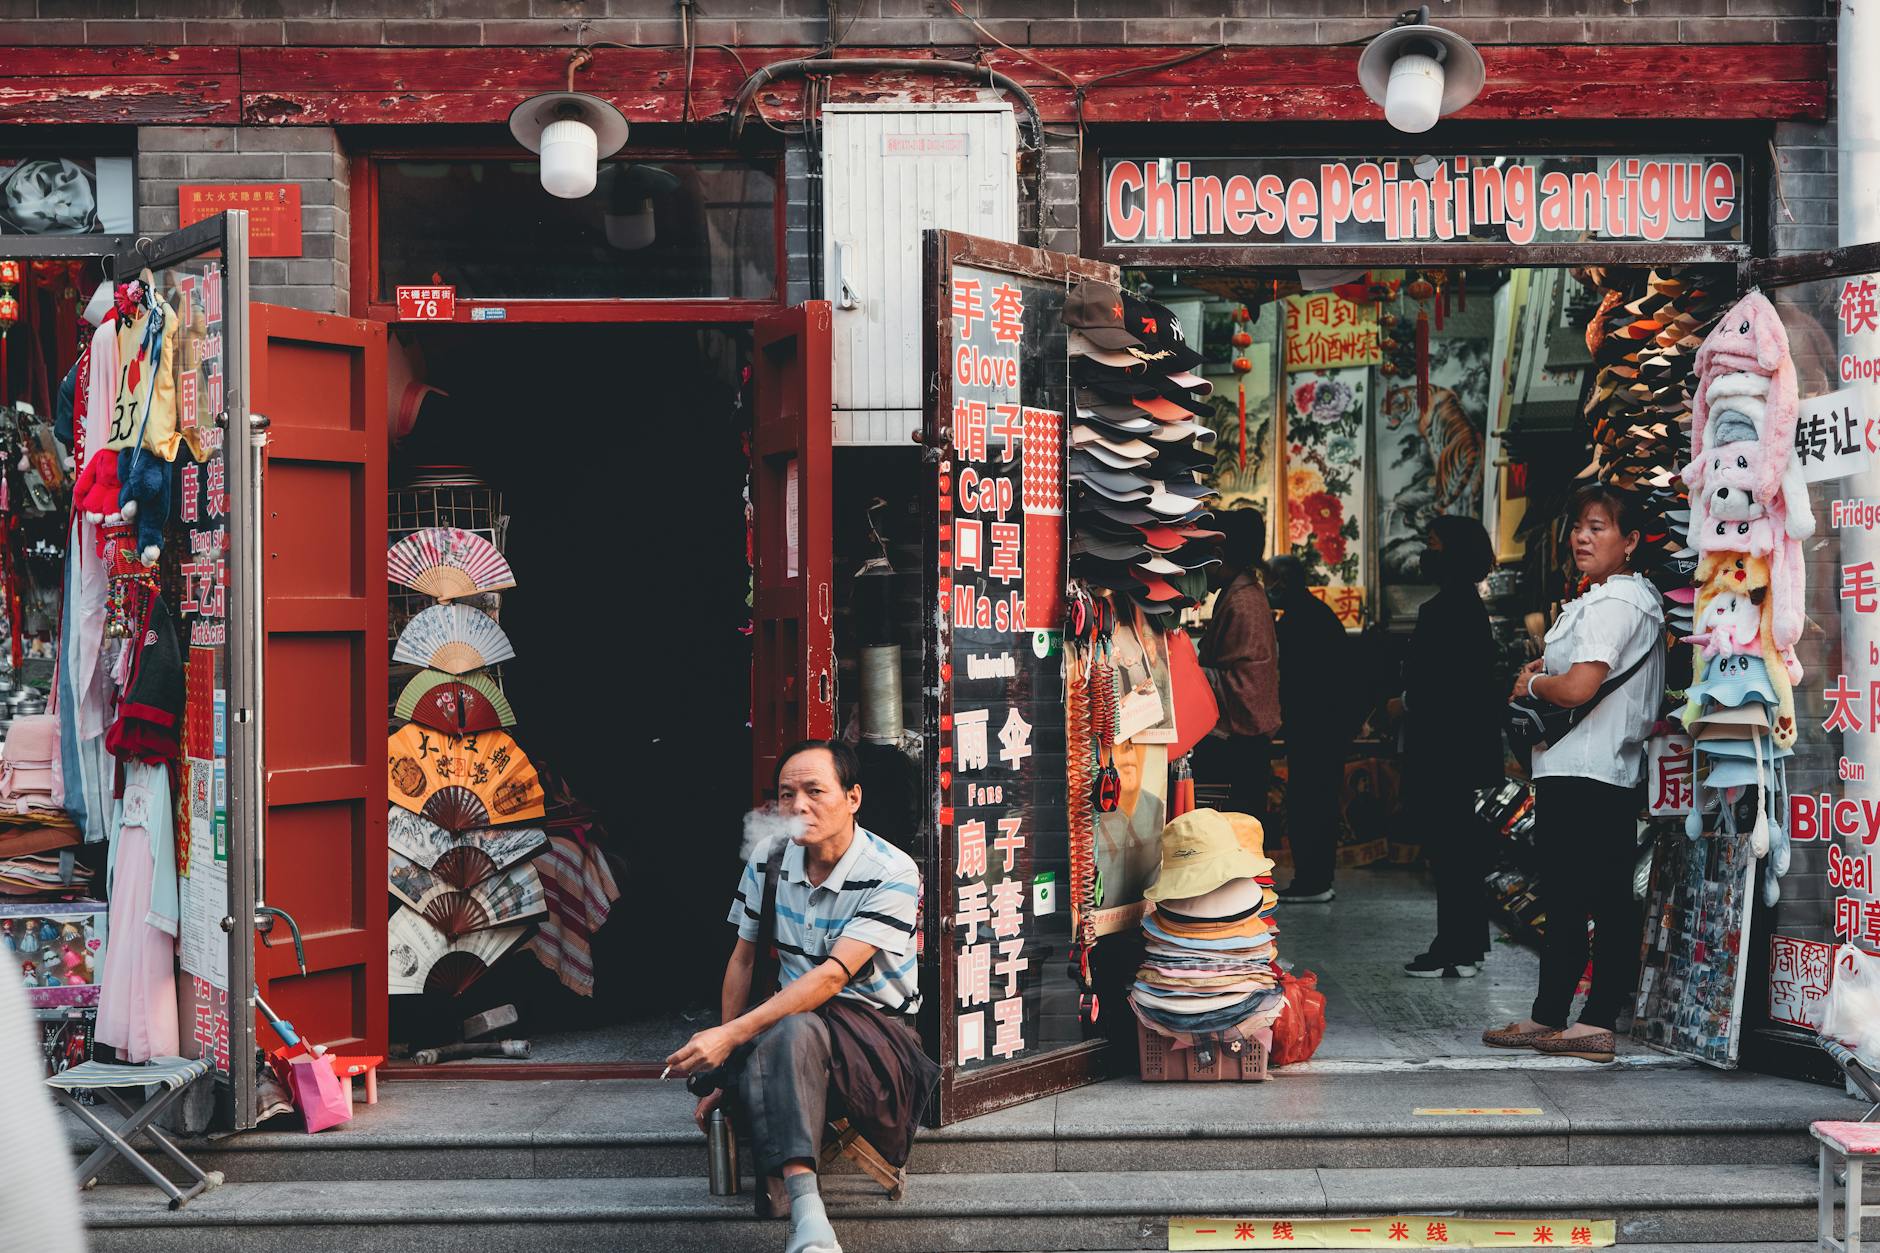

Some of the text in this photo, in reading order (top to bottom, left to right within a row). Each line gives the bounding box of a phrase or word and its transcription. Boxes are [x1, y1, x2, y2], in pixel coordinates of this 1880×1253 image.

[414, 300, 438, 318] 76
[953, 279, 1024, 346] 手套
[956, 345, 1018, 388] Glove
[953, 398, 1023, 464] 帽子
[1795, 406, 1861, 466] 转让
[180, 457, 224, 523] 唐装
[958, 467, 1013, 521] Cap
[954, 517, 1022, 585] 口罩
[190, 620, 225, 646] Art&cra
[954, 585, 1025, 634] Mask
[954, 707, 1033, 773] 雨伞
[1838, 756, 1865, 781] Sun
[967, 783, 1003, 807] Fans
[1652, 742, 1694, 810] 扇
[955, 817, 1026, 879] 扇子
[1827, 843, 1873, 894] Seal
[955, 877, 1026, 945] 手套
[957, 938, 1028, 1008] 帽子
[957, 997, 1025, 1067] 口罩
[1195, 1222, 1295, 1242] 一米线
[1350, 1222, 1449, 1242] 一米线
[1494, 1226, 1593, 1246] 一米线
